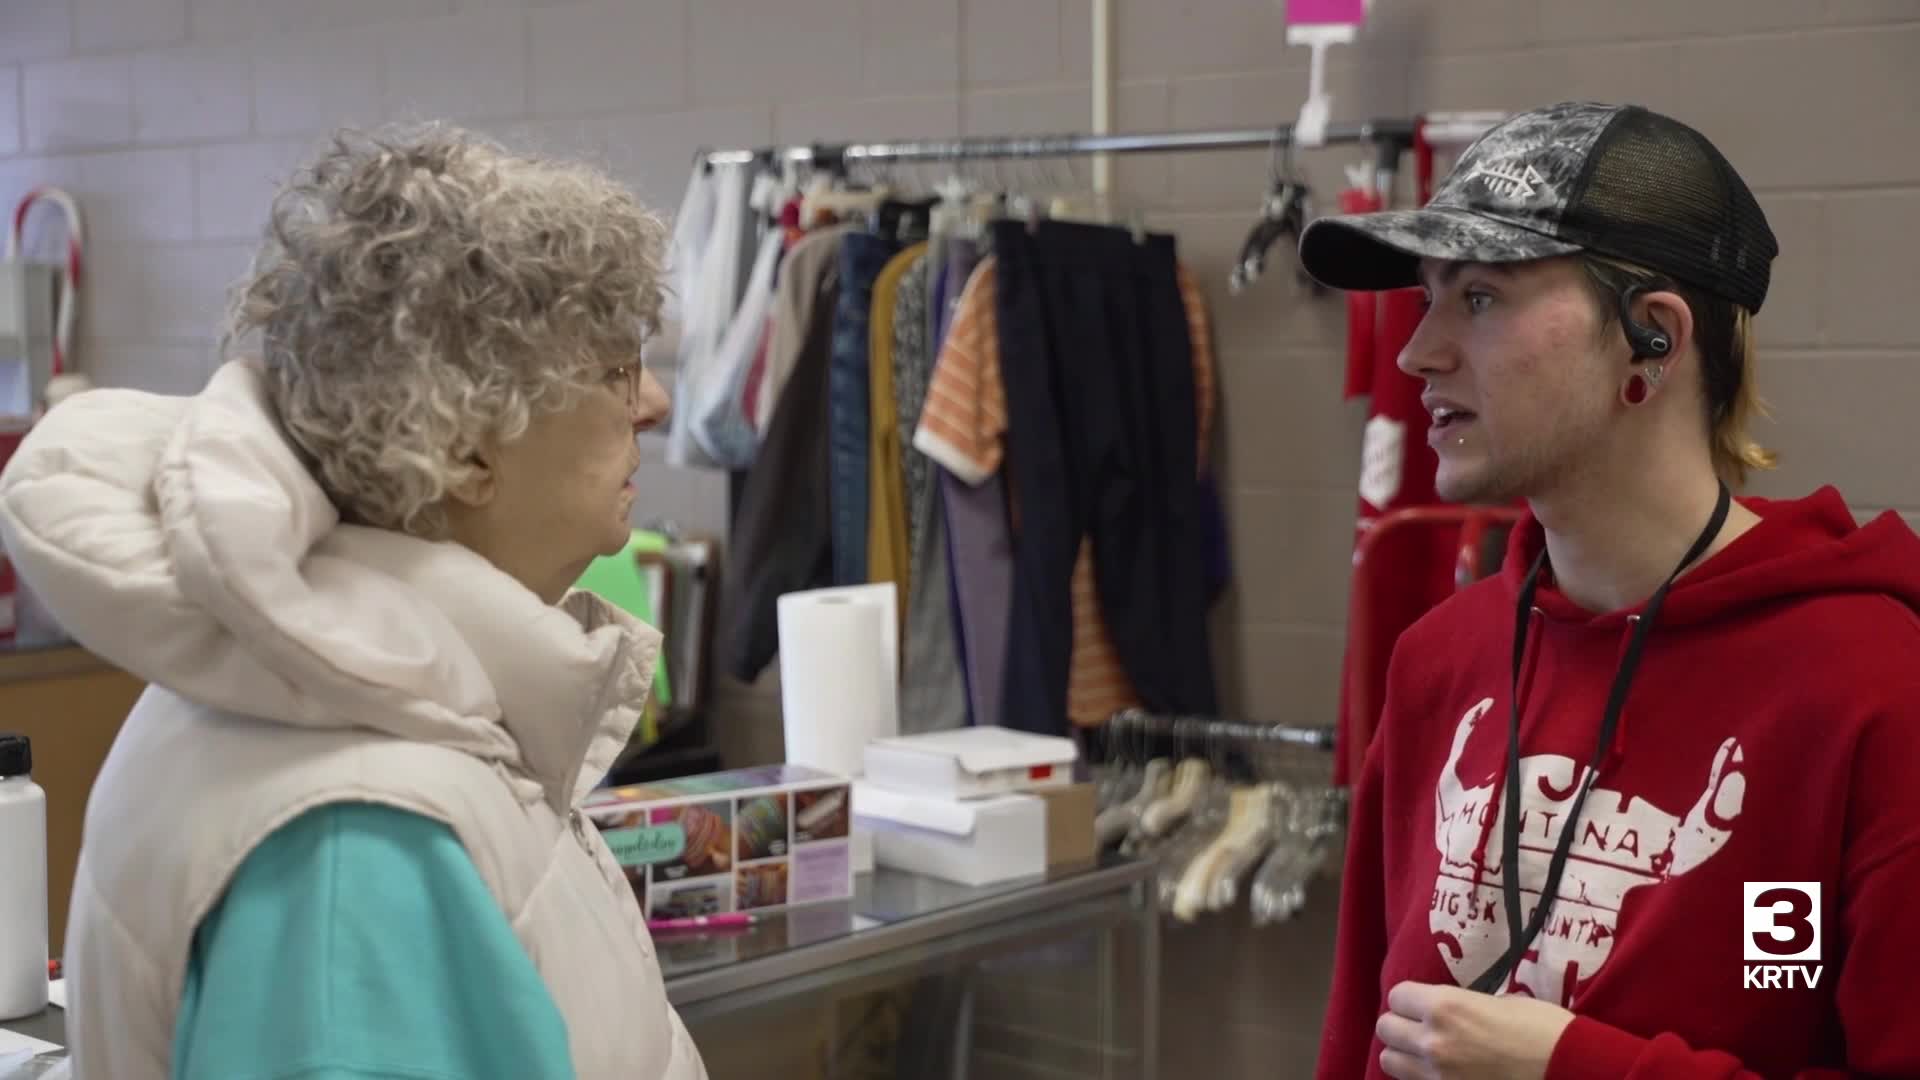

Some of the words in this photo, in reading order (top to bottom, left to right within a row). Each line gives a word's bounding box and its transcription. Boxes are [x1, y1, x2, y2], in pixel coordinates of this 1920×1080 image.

[1459, 801, 1638, 858] MOTNA
[1430, 889, 1460, 916] BIG
[1467, 891, 1497, 924] SK
